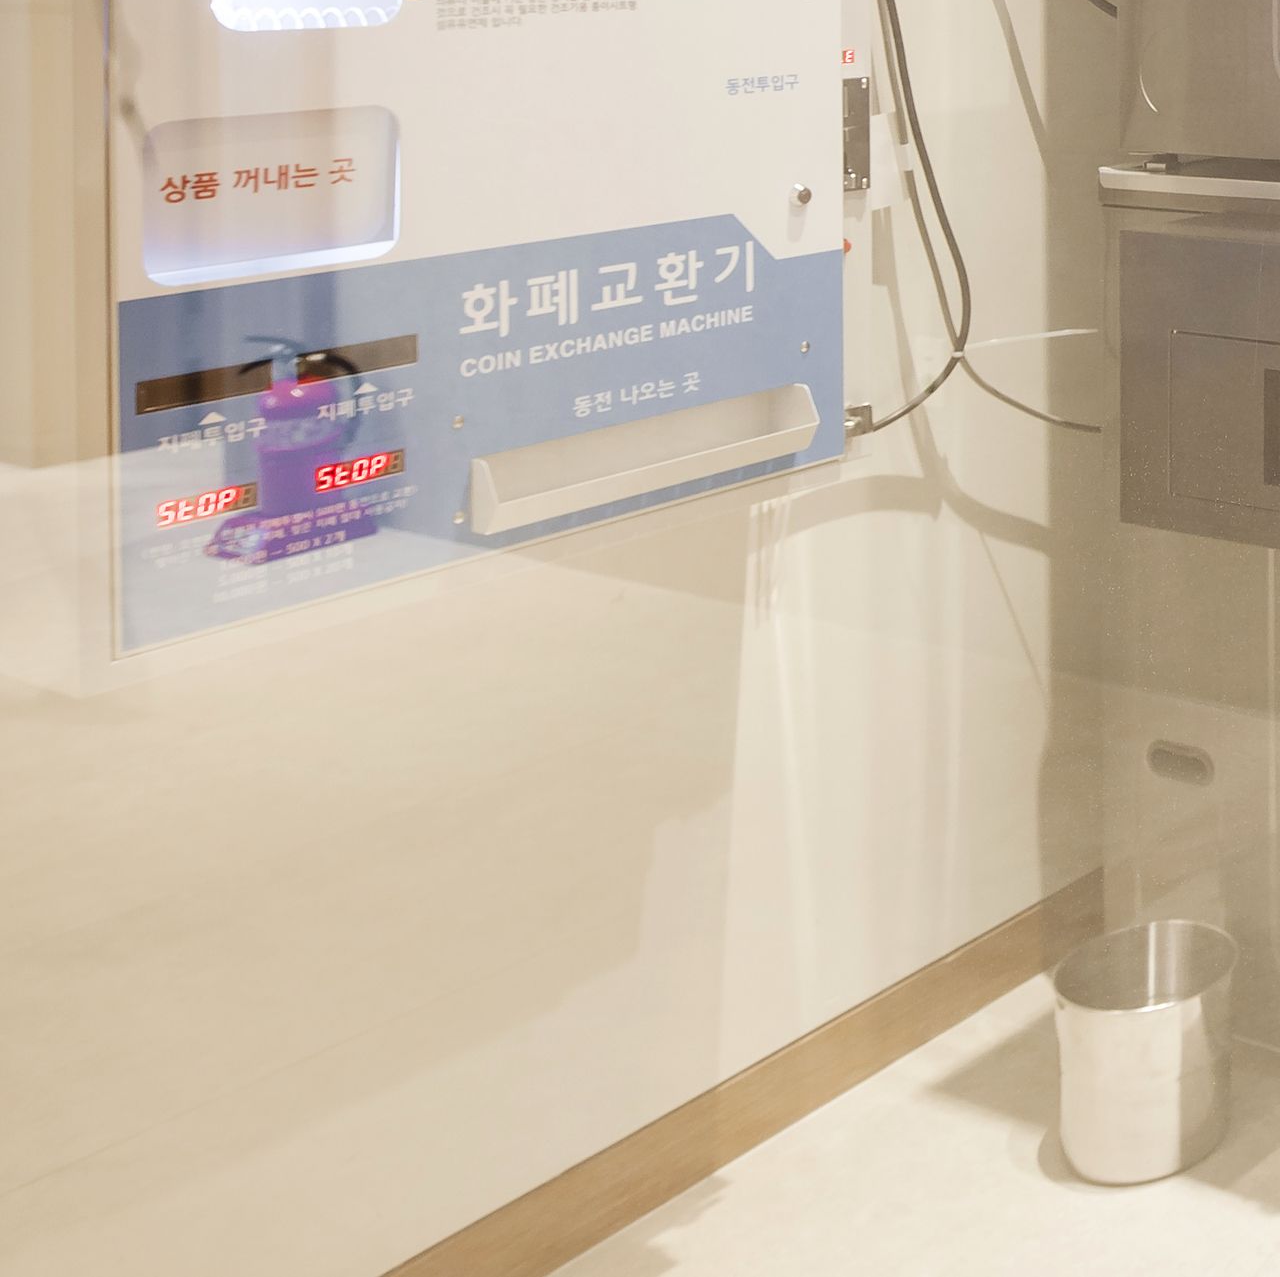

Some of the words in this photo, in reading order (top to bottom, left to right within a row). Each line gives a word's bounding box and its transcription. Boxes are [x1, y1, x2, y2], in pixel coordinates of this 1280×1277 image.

[725, 74, 800, 97] 동전투입구
[160, 171, 221, 203] 상품
[233, 163, 320, 194] 꺼내는
[329, 158, 355, 185] 곳
[458, 240, 756, 338] 화폐교환기
[460, 349, 522, 378] COIN
[529, 324, 654, 365] EXCHANGE
[660, 304, 754, 339] MACHINE
[317, 388, 415, 422] 지폐투입구
[573, 389, 613, 419] 동전
[620, 379, 677, 406] 나오는
[683, 371, 702, 394] 곳
[158, 417, 268, 453] 지폐투입구
